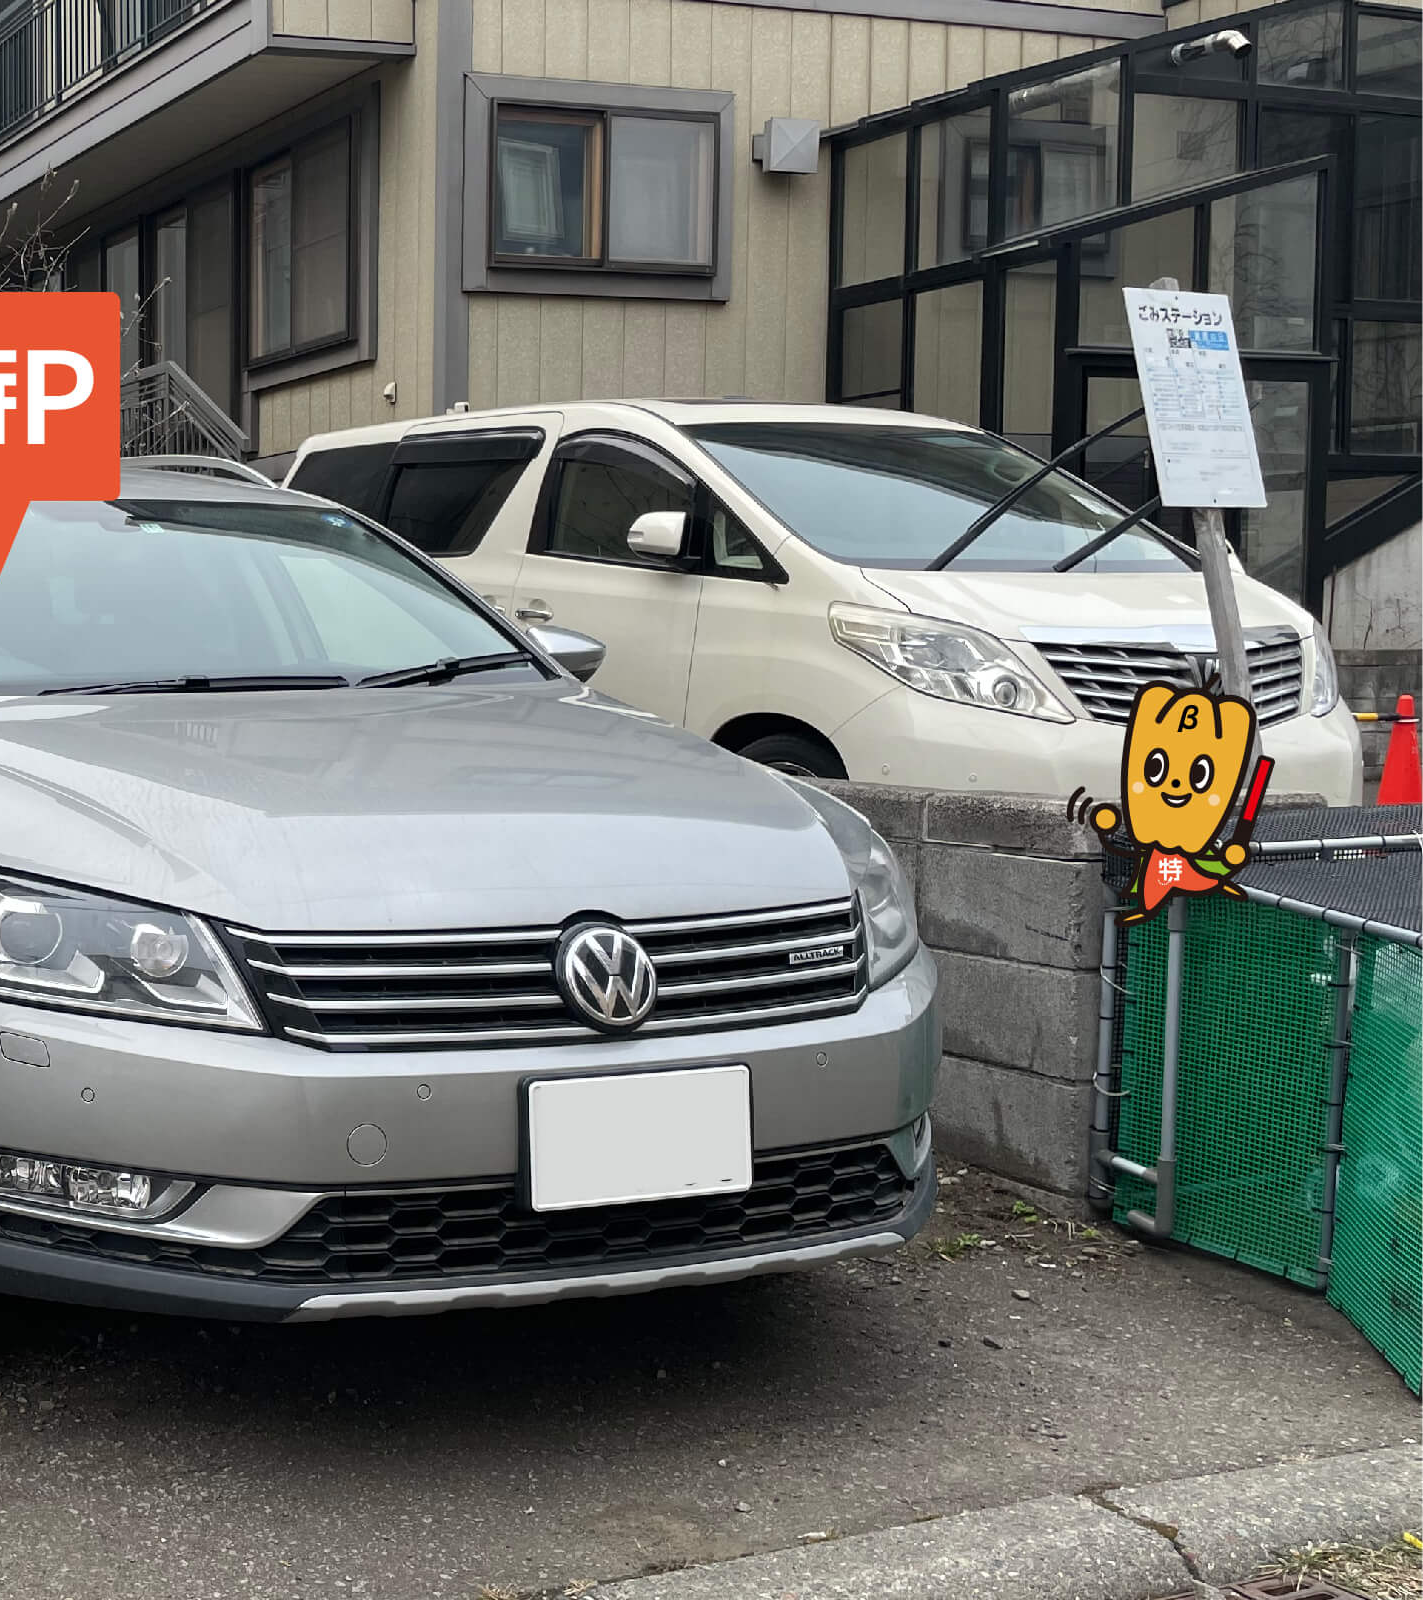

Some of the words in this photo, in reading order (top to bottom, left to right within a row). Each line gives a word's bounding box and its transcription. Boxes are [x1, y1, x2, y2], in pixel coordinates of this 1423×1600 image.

[1138, 304, 1223, 326] ごみステーション
[792, 946, 843, 962] ALLTRACK
